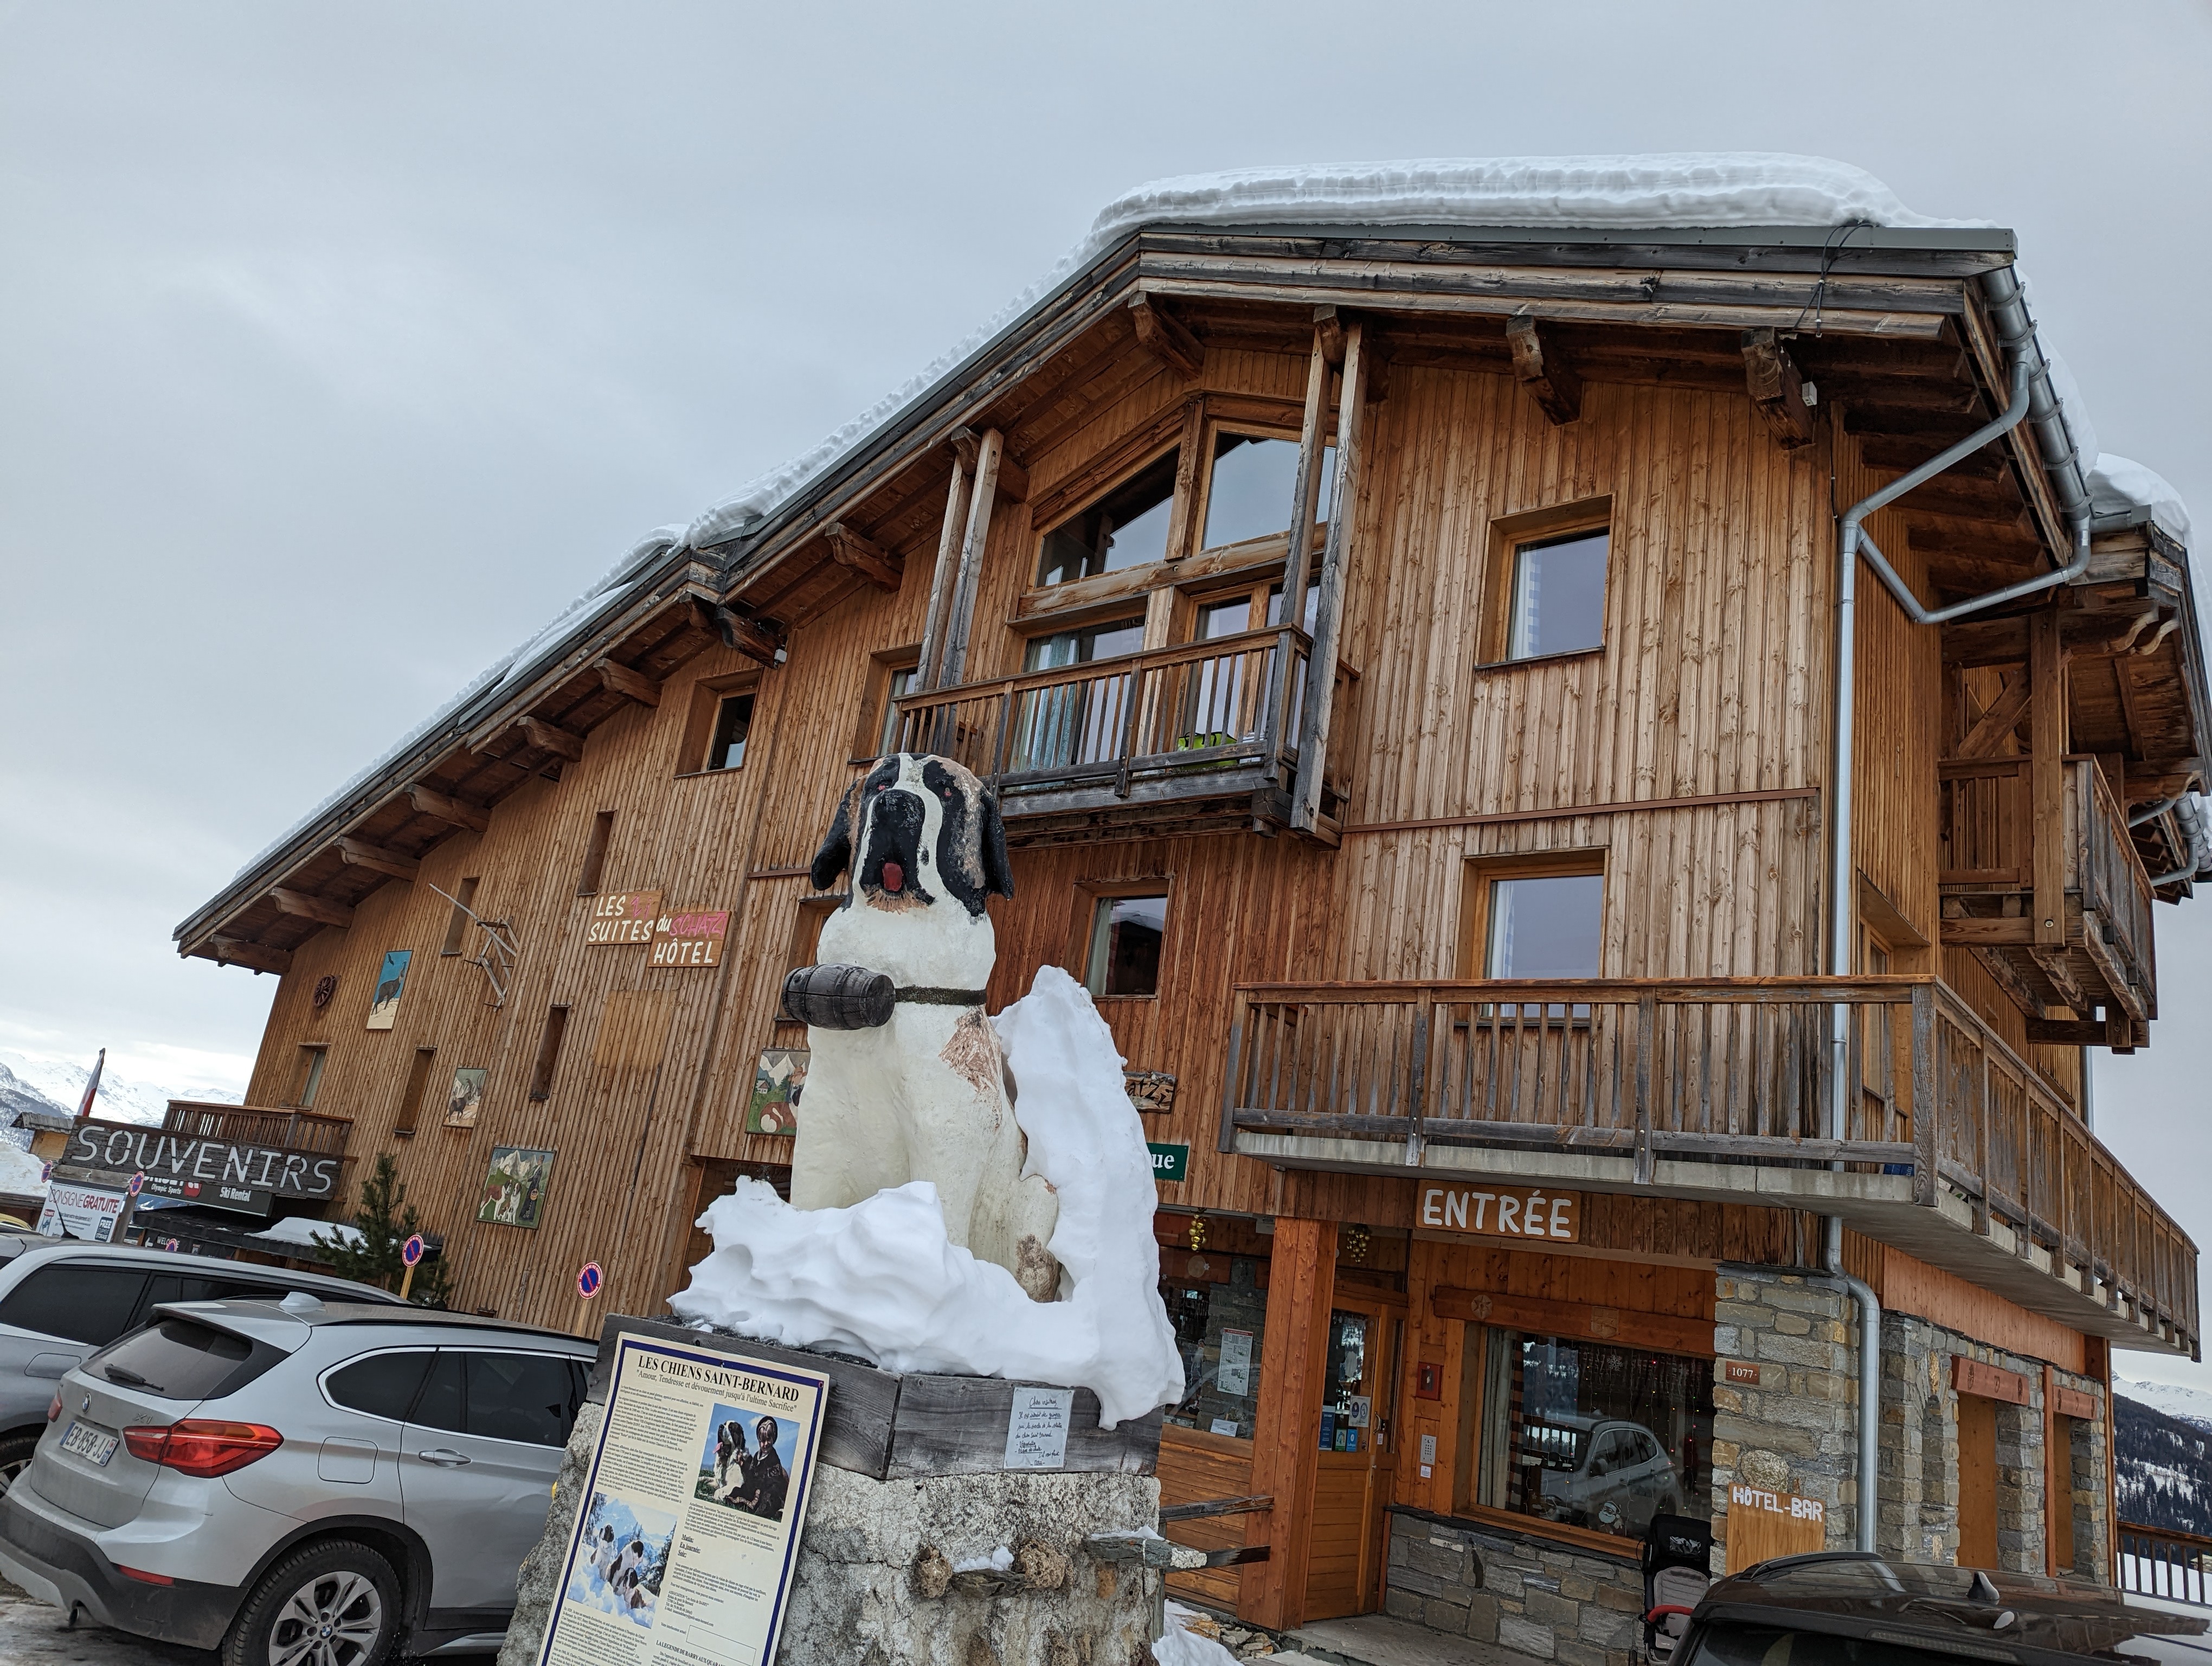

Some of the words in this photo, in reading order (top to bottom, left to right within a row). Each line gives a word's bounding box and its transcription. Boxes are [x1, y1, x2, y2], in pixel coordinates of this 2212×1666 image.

[596, 895, 626, 917] LES
[588, 919, 654, 942] SUITES
[656, 914, 673, 932] du
[653, 937, 713, 964] HÔTEL
[71, 1124, 338, 1193] SOUVENIRS
[49, 1189, 86, 1208] CONSIGNE
[83, 1195, 120, 1214] GRATUITE
[151, 1183, 168, 1193] Olympic
[168, 1186, 182, 1195] Sports
[220, 1187, 230, 1199] Ski
[229, 1188, 251, 1202] Rental
[99, 1220, 112, 1228] FREE
[1424, 1189, 1572, 1238] ENTRÉE
[636, 1369, 658, 1382] "Amour,
[659, 1374, 684, 1387] Tendresse
[691, 1382, 725, 1396] dévouement
[725, 1389, 745, 1401] jusqu'à
[746, 1394, 767, 1406] l'ultime
[768, 1398, 797, 1412] Sacrifice"
[638, 1355, 659, 1370] LES
[660, 1360, 702, 1380] CHIENS
[704, 1369, 799, 1402] SAINT-BERNARD
[135, 1412, 153, 1425] X1
[1733, 1486, 1823, 1522] HÔTEL-BAR
[661, 1642, 679, 1652] LEGENDE
[685, 1651, 698, 1659] BARRY
